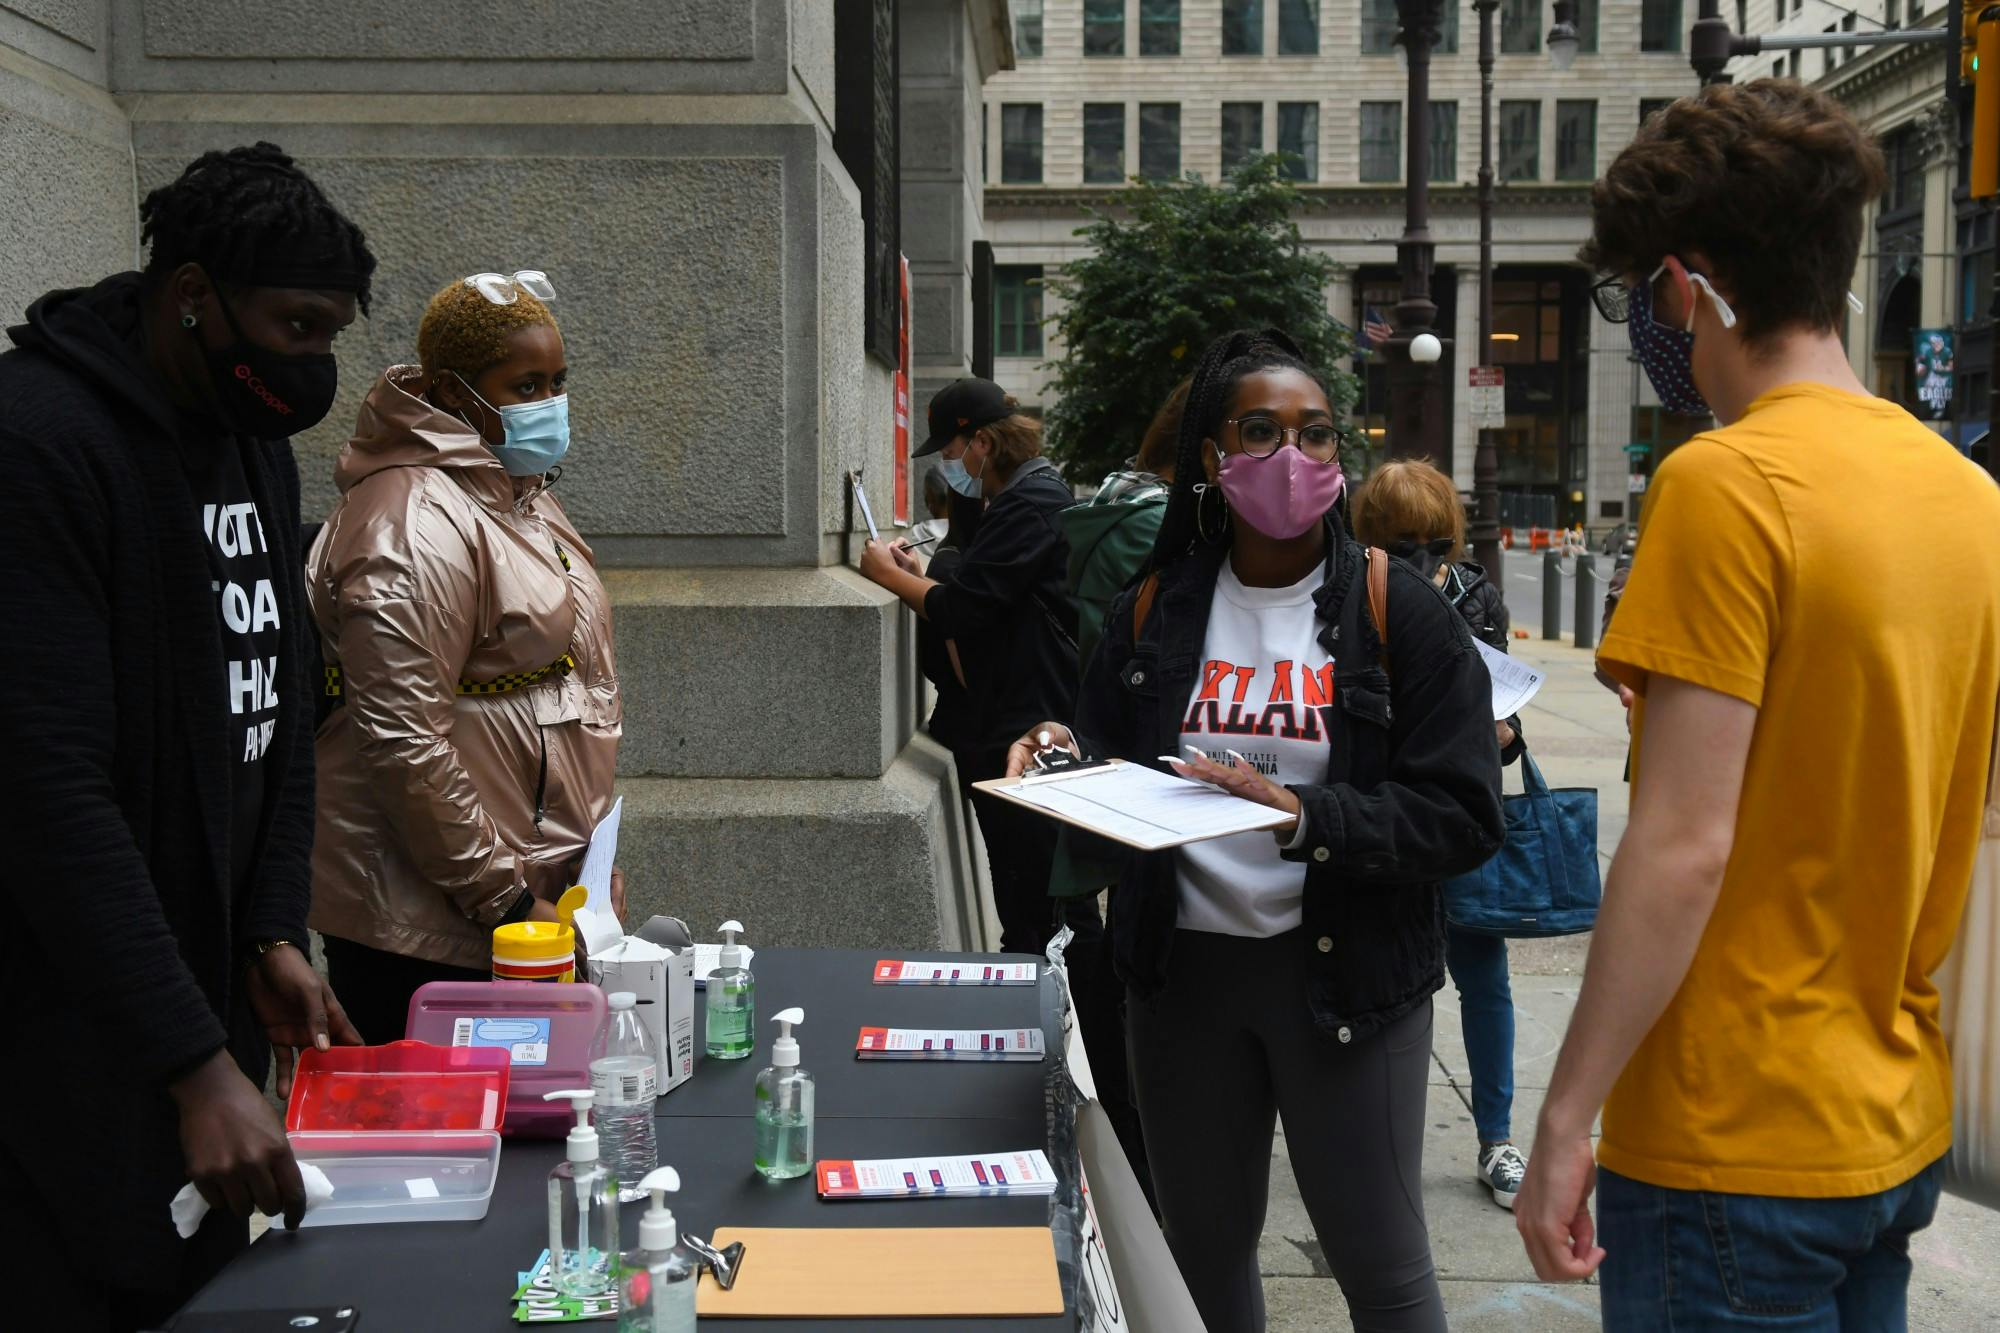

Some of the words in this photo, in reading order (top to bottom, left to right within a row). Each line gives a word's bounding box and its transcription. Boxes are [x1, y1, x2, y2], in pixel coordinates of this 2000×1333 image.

[247, 377, 296, 415] Cooper
[1918, 387, 1953, 401] EAGLES
[1206, 751, 1233, 760] UNITE
[1241, 752, 1278, 762] STATES
